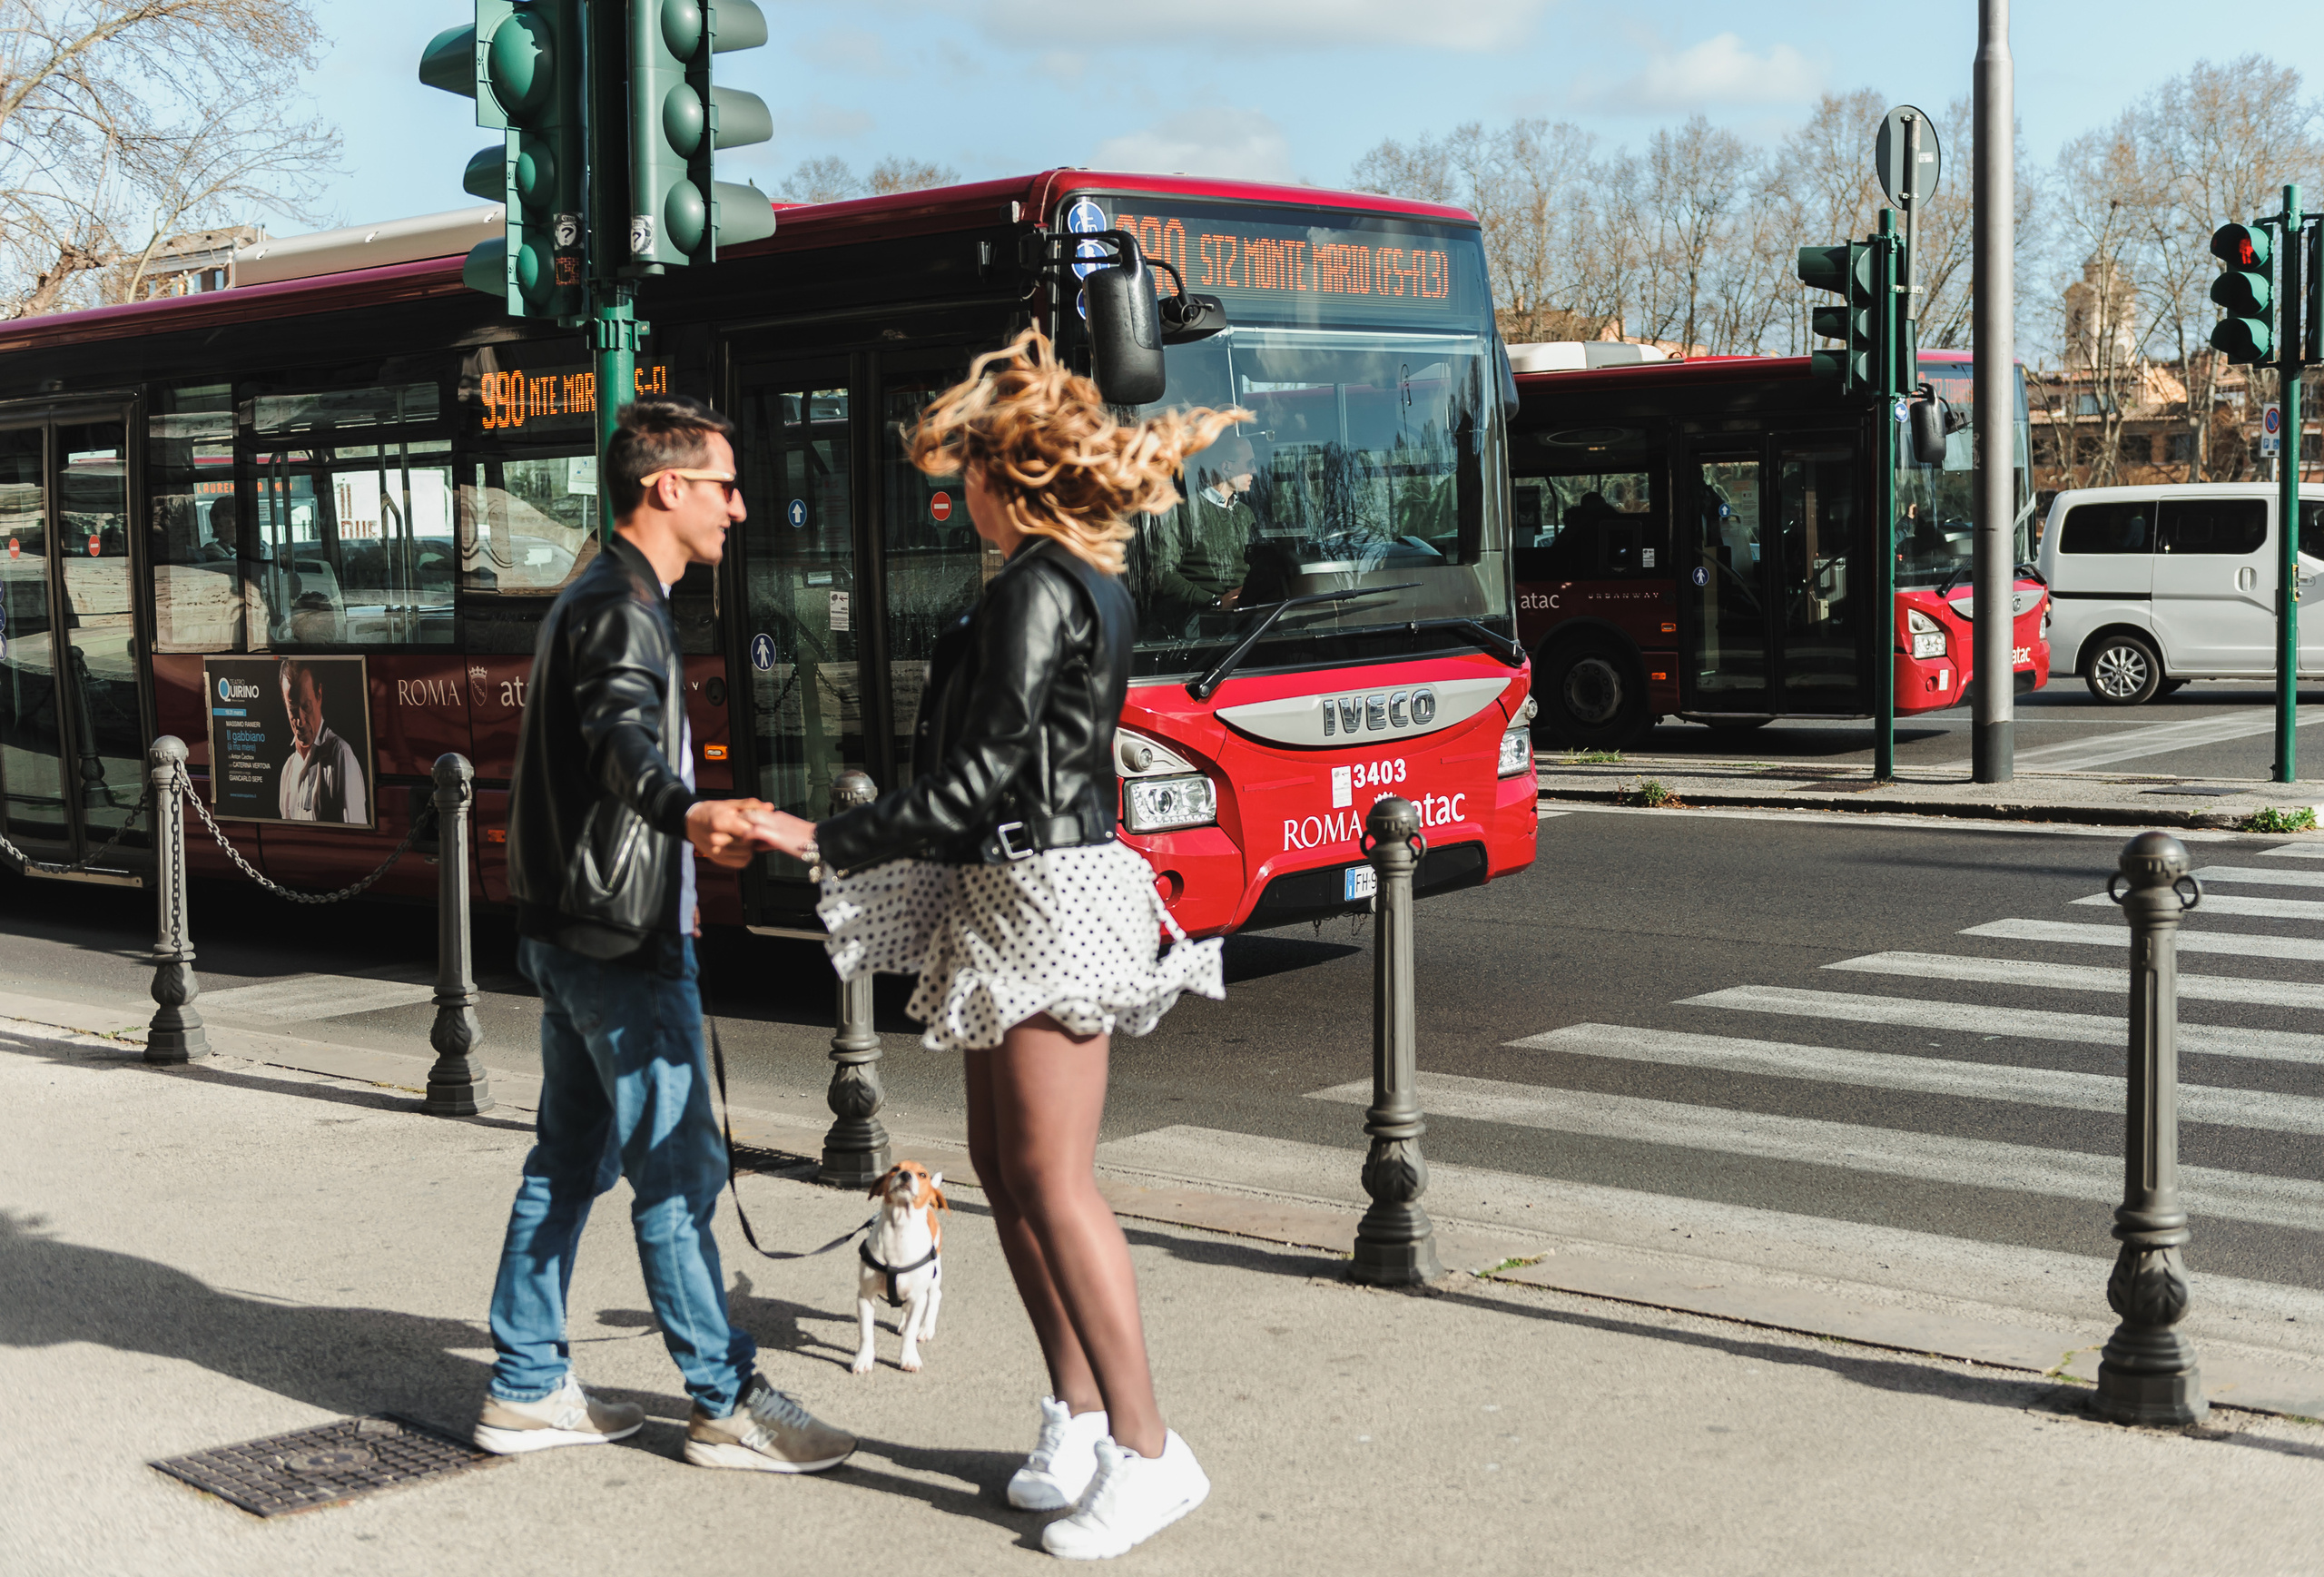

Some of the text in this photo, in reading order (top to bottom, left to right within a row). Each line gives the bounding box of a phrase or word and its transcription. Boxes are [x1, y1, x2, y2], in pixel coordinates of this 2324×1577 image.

[1115, 213, 1187, 297] 90
[1244, 238, 1306, 291] MONTE
[1313, 242, 1371, 294] MARIO
[481, 370, 526, 429] 990
[529, 376, 557, 416] NTE
[563, 372, 596, 413] MAR
[1521, 592, 1560, 609] atac
[2012, 646, 2031, 665] atac
[218, 677, 260, 702] QUIRINO
[398, 679, 461, 706] ROMA
[500, 675, 529, 707] at
[1323, 688, 1436, 736] IVECO
[232, 730, 265, 744] gabbiano
[1353, 758, 1407, 788] 3403
[1283, 810, 1363, 852] ROMA
